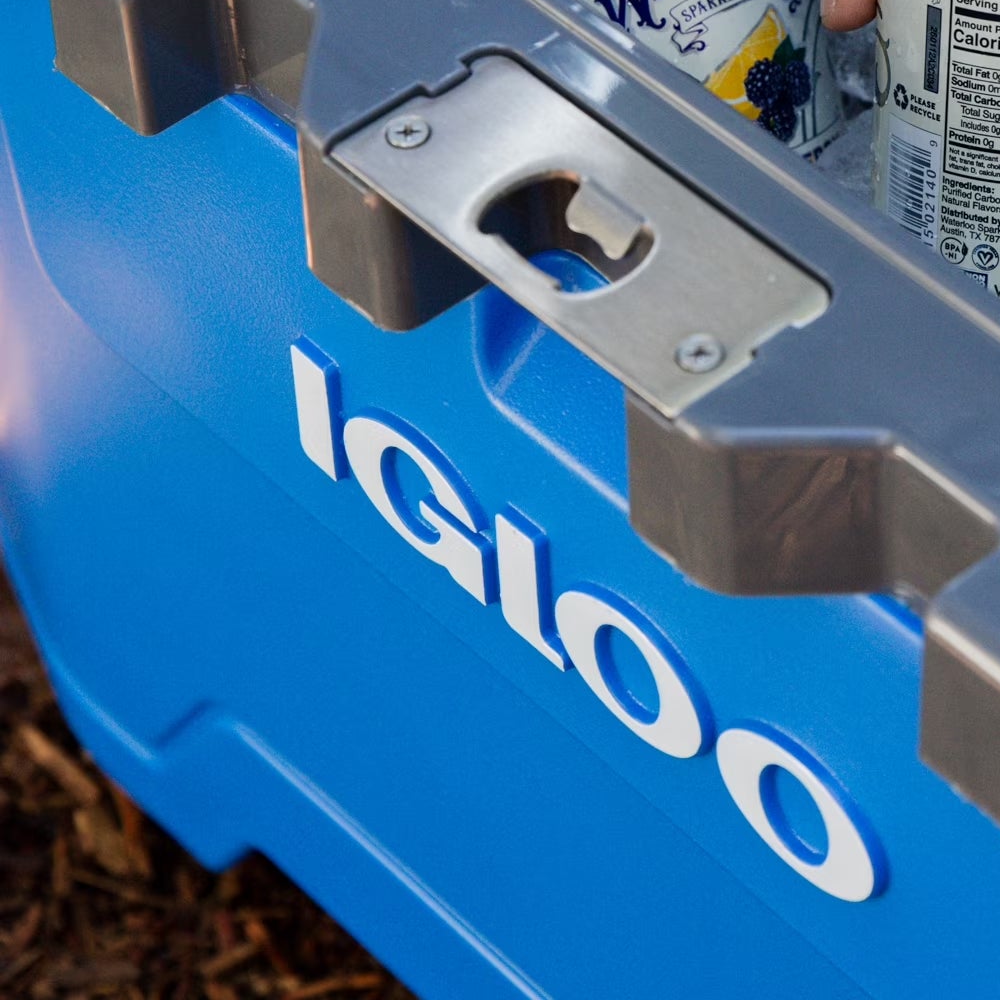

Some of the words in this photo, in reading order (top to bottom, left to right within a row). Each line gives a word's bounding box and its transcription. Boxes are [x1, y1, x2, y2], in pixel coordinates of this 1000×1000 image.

[954, 18, 992, 33] Amount
[952, 63, 973, 76] Total
[975, 68, 990, 79] Fat
[951, 76, 986, 92] Sodium
[910, 94, 936, 110] PLEASE
[950, 89, 972, 101] Total
[910, 105, 941, 122] RECYCLE
[960, 105, 981, 117] Total
[960, 119, 990, 133] Includes
[991, 125, 1000, 136] 0g
[948, 130, 981, 145] Protein
[982, 137, 994, 149] 0g
[949, 148, 960, 156] Not
[966, 151, 998, 163] significant
[959, 157, 975, 166] trans
[948, 162, 969, 172] vitamin
[942, 176, 995, 194] Ingredients:
[942, 185, 972, 199] Purified
[941, 195, 970, 208] Natural
[941, 206, 989, 223] Distributed
[940, 215, 975, 230] Waterloo
[940, 224, 967, 238] Austin,
[969, 231, 982, 241] TX
[945, 242, 961, 252] BPA
[291, 343, 880, 902] IGLOO
